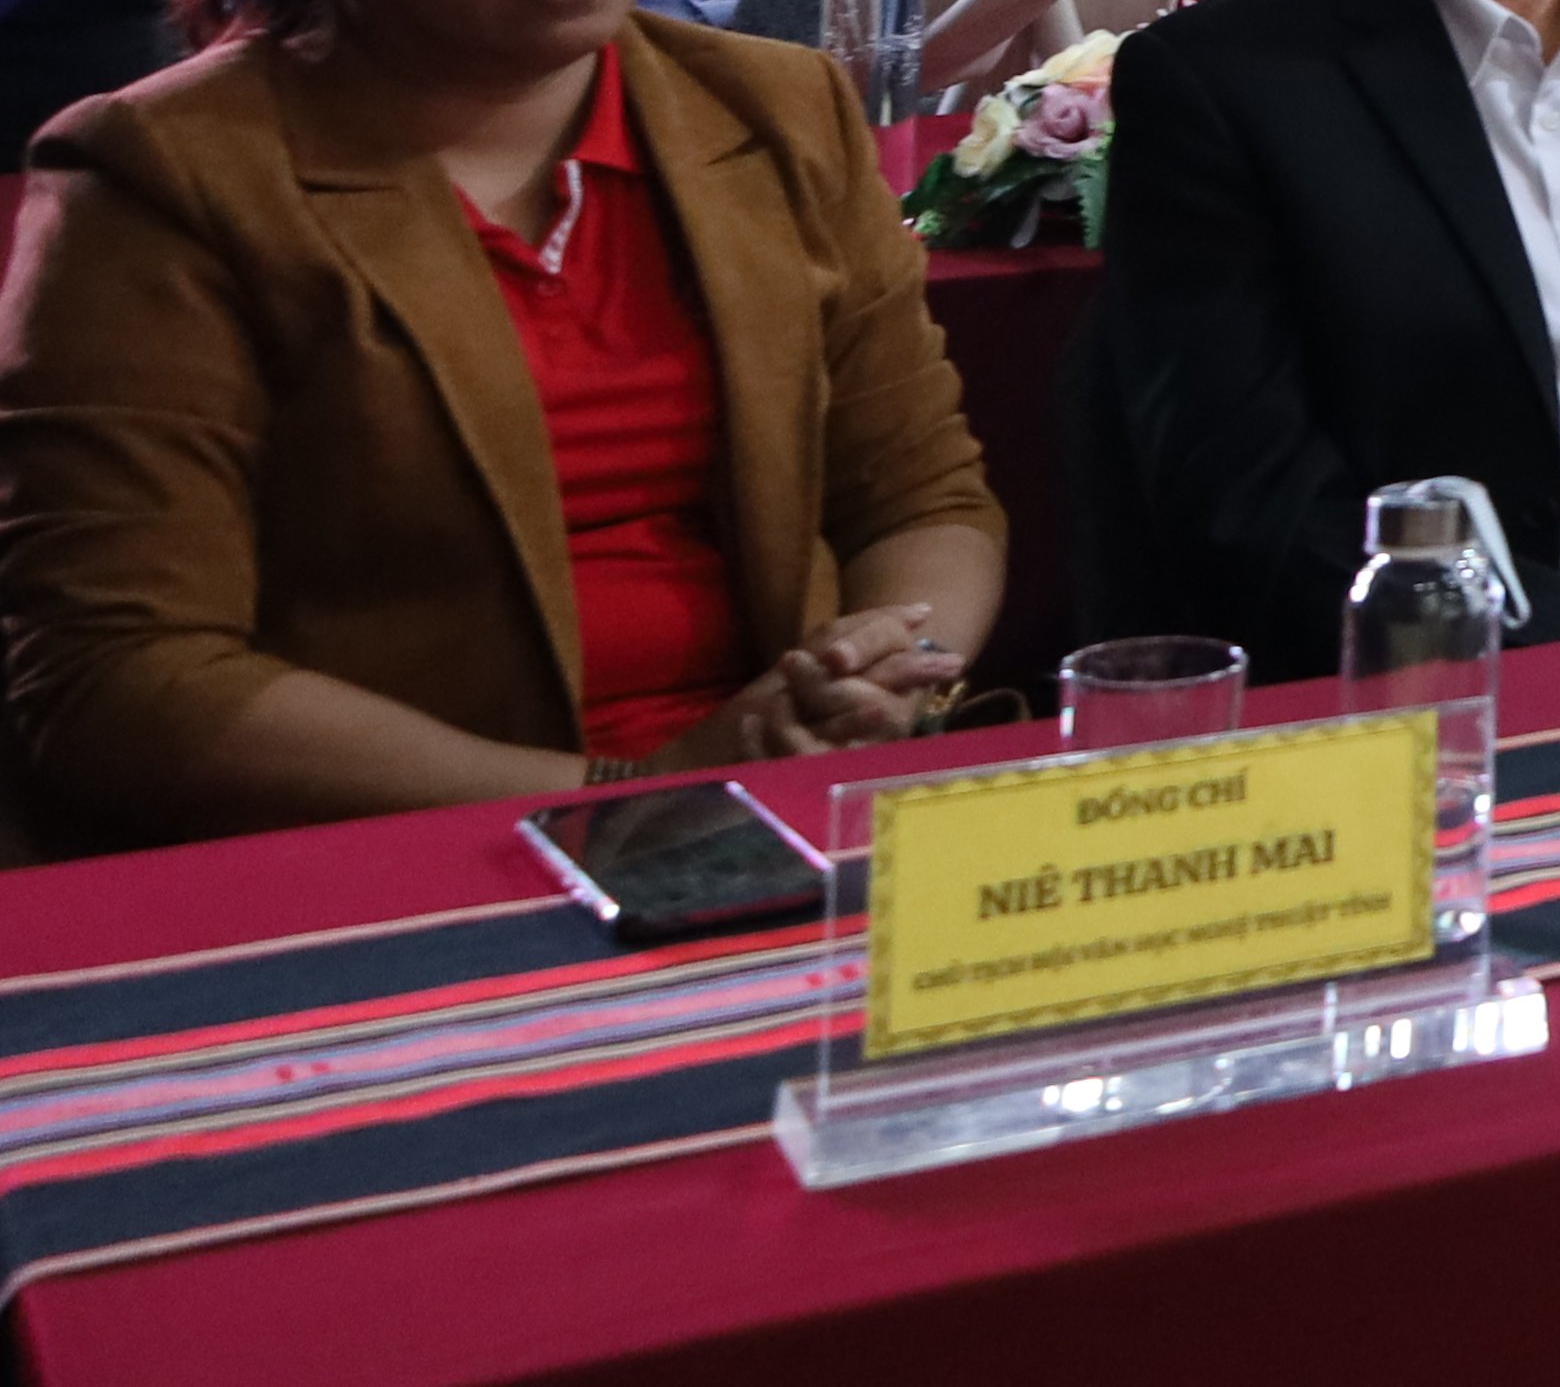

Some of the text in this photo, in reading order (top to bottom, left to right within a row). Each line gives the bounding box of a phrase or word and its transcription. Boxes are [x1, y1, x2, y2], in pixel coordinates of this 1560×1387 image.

[1076, 765, 1249, 825] ĐỒNG CHÍ
[977, 828, 1335, 920] NIÊ THANH MAI
